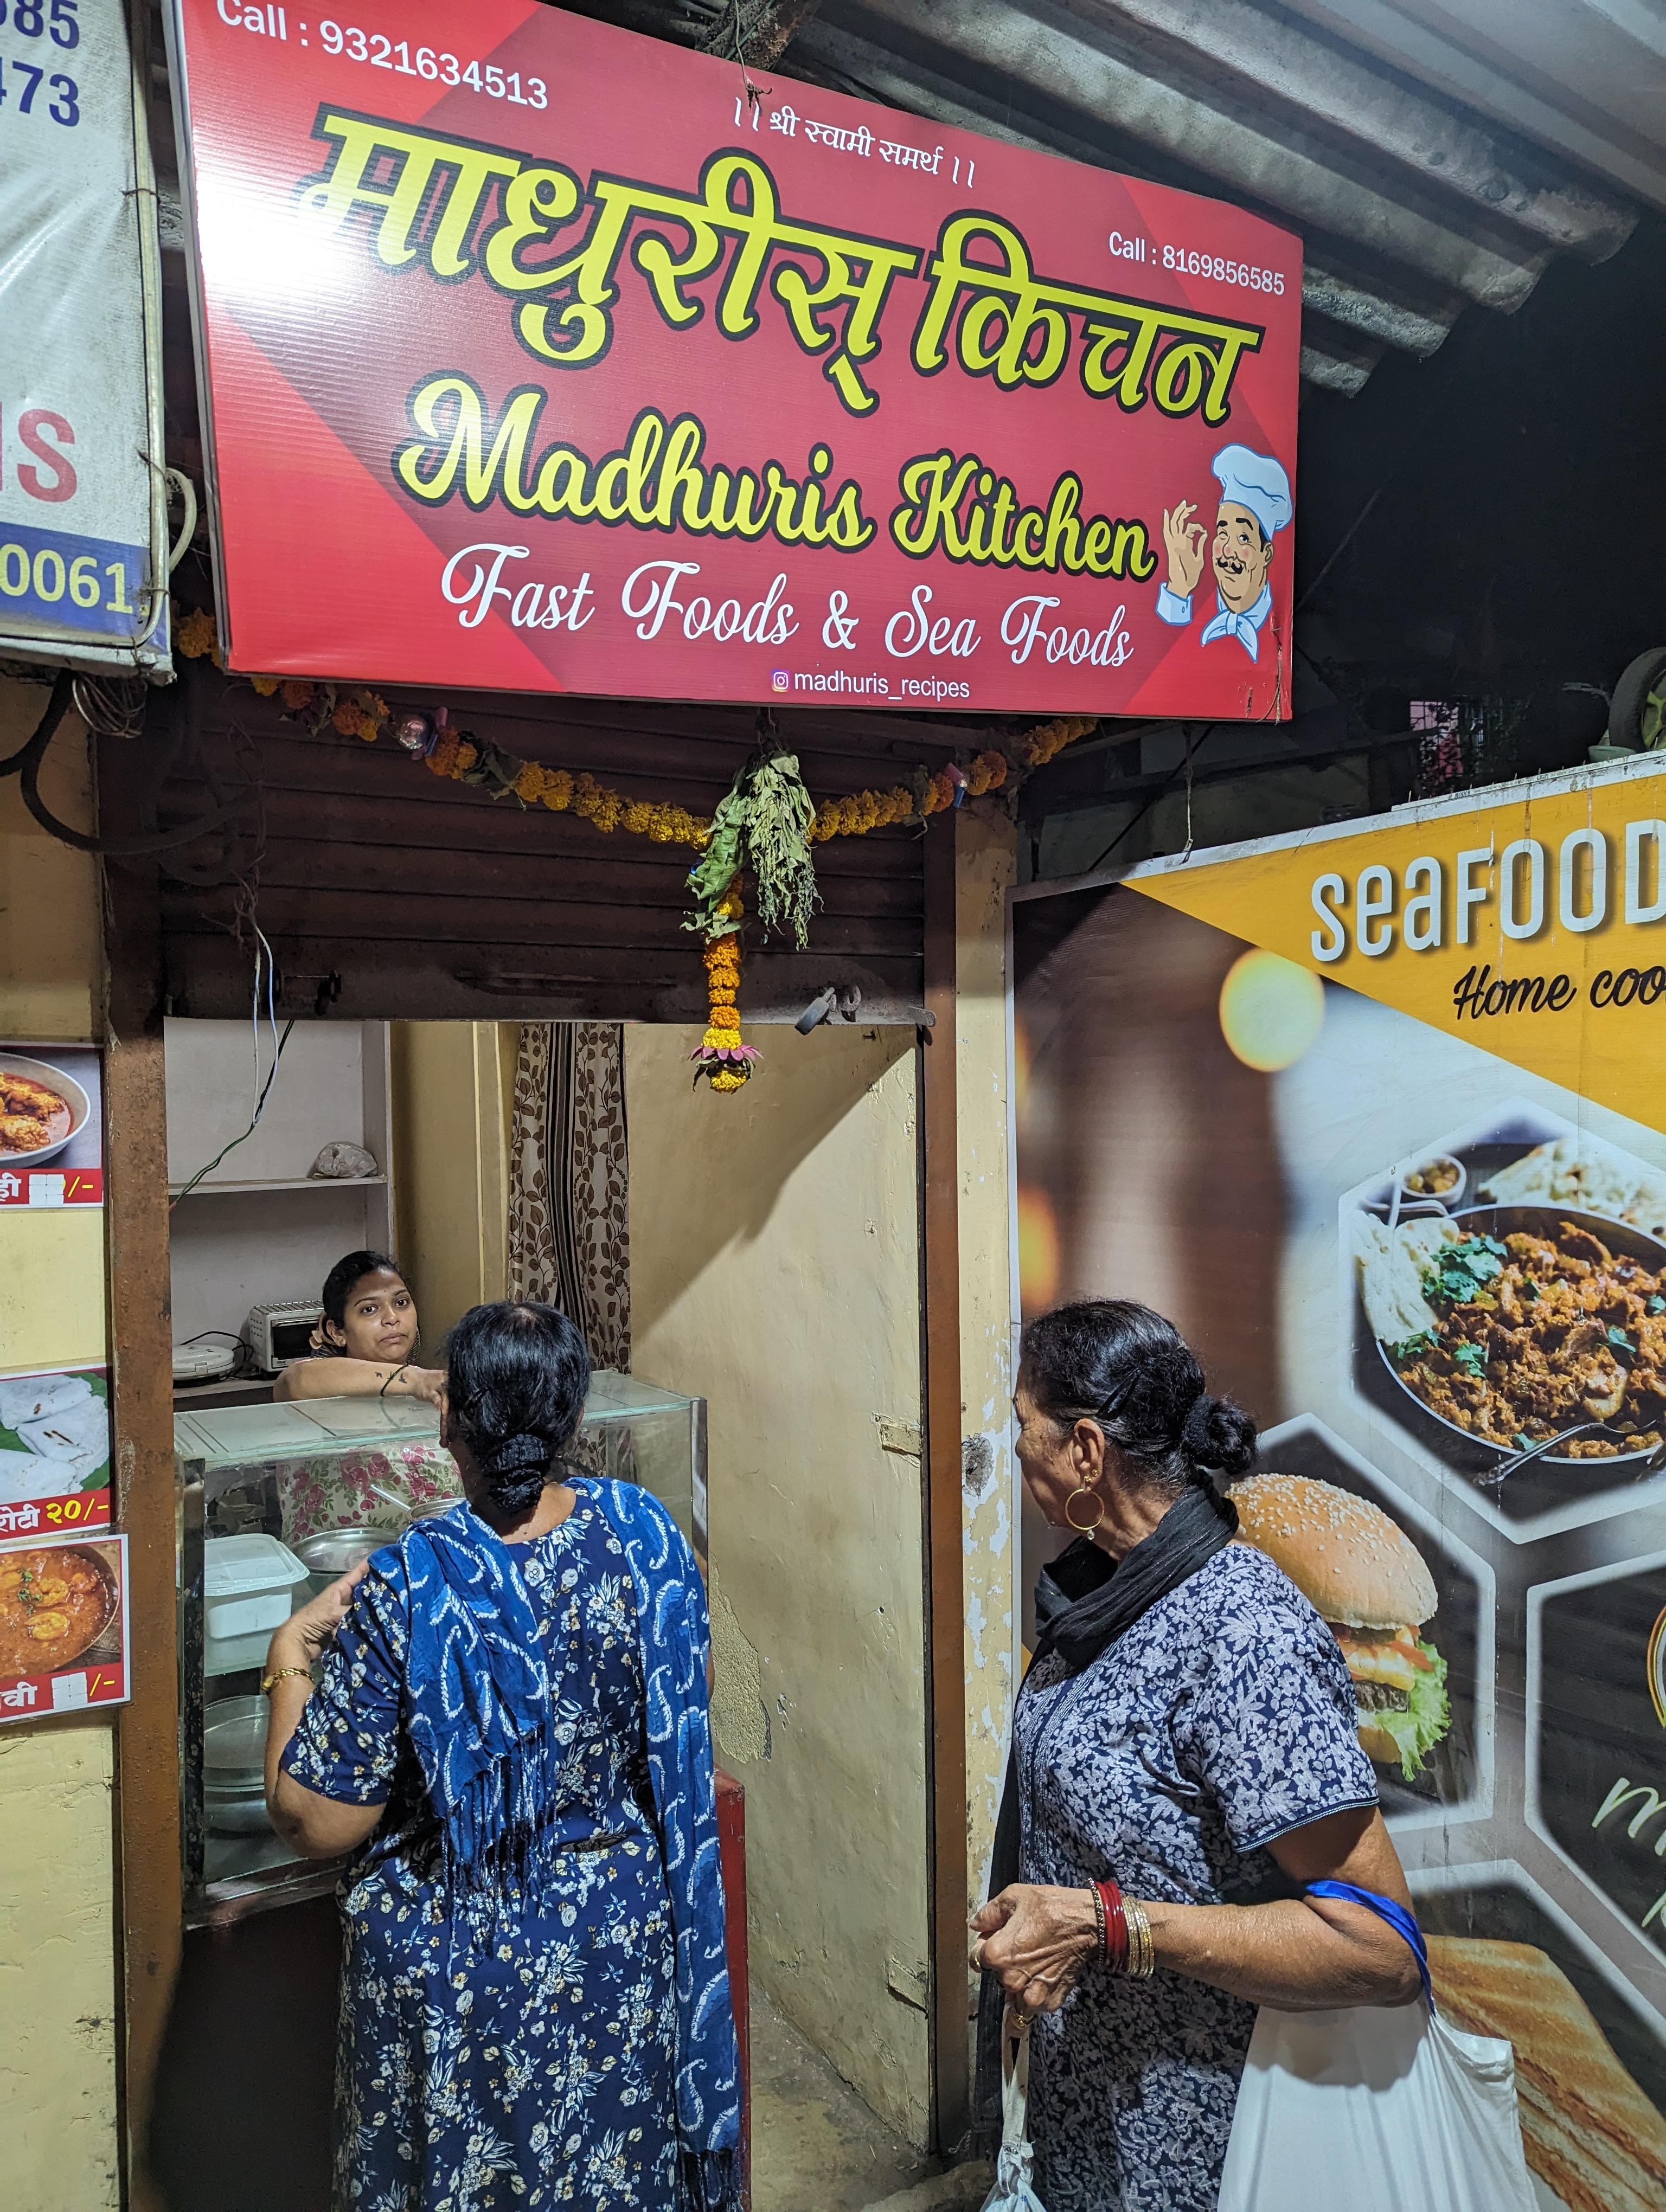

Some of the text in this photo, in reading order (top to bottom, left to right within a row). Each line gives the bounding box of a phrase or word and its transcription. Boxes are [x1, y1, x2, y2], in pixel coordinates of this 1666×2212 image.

[0, 0, 79, 49] 85
[217, 0, 286, 40] Call
[319, 20, 548, 109] 9321634513
[0, 56, 80, 127] 73
[770, 106, 800, 137] श्री
[805, 125, 875, 157] स्वामी
[879, 139, 944, 175] समर्थ
[1109, 232, 1145, 262] Call
[1162, 245, 1285, 295] 8169856585
[911, 209, 1266, 427] किचन
[391, 370, 1158, 582] Madhuris Kitchen
[441, 543, 1134, 667] Fast Foods & Sea Foods
[794, 670, 970, 702] madhuris_recipes
[1453, 964, 1666, 1020] Home coo
